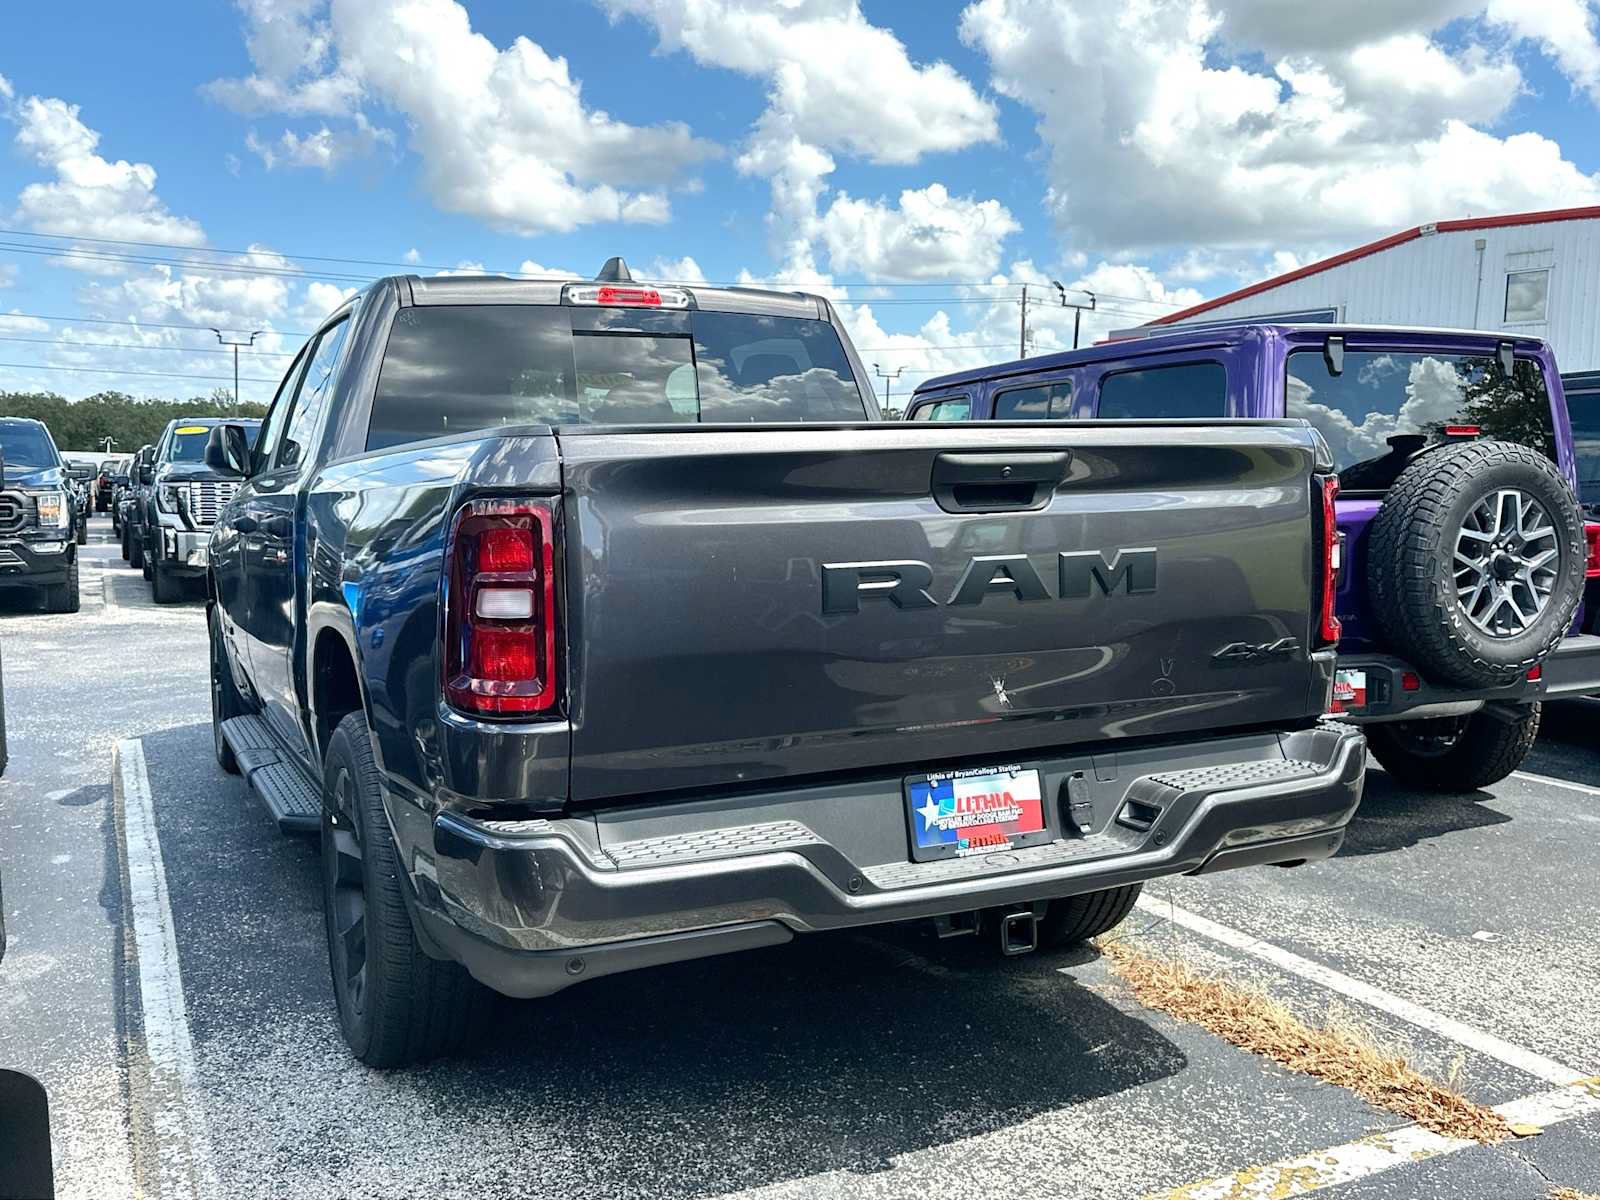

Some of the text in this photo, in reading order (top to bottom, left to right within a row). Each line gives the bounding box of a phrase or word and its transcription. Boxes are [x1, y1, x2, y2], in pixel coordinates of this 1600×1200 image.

[821, 546, 1158, 615] RAM
[1211, 635, 1302, 663] 4x4
[926, 772, 945, 781] Lithia
[955, 767, 998, 778] Bryan/College
[998, 764, 1021, 773] Station
[956, 791, 1017, 814] LITHIA
